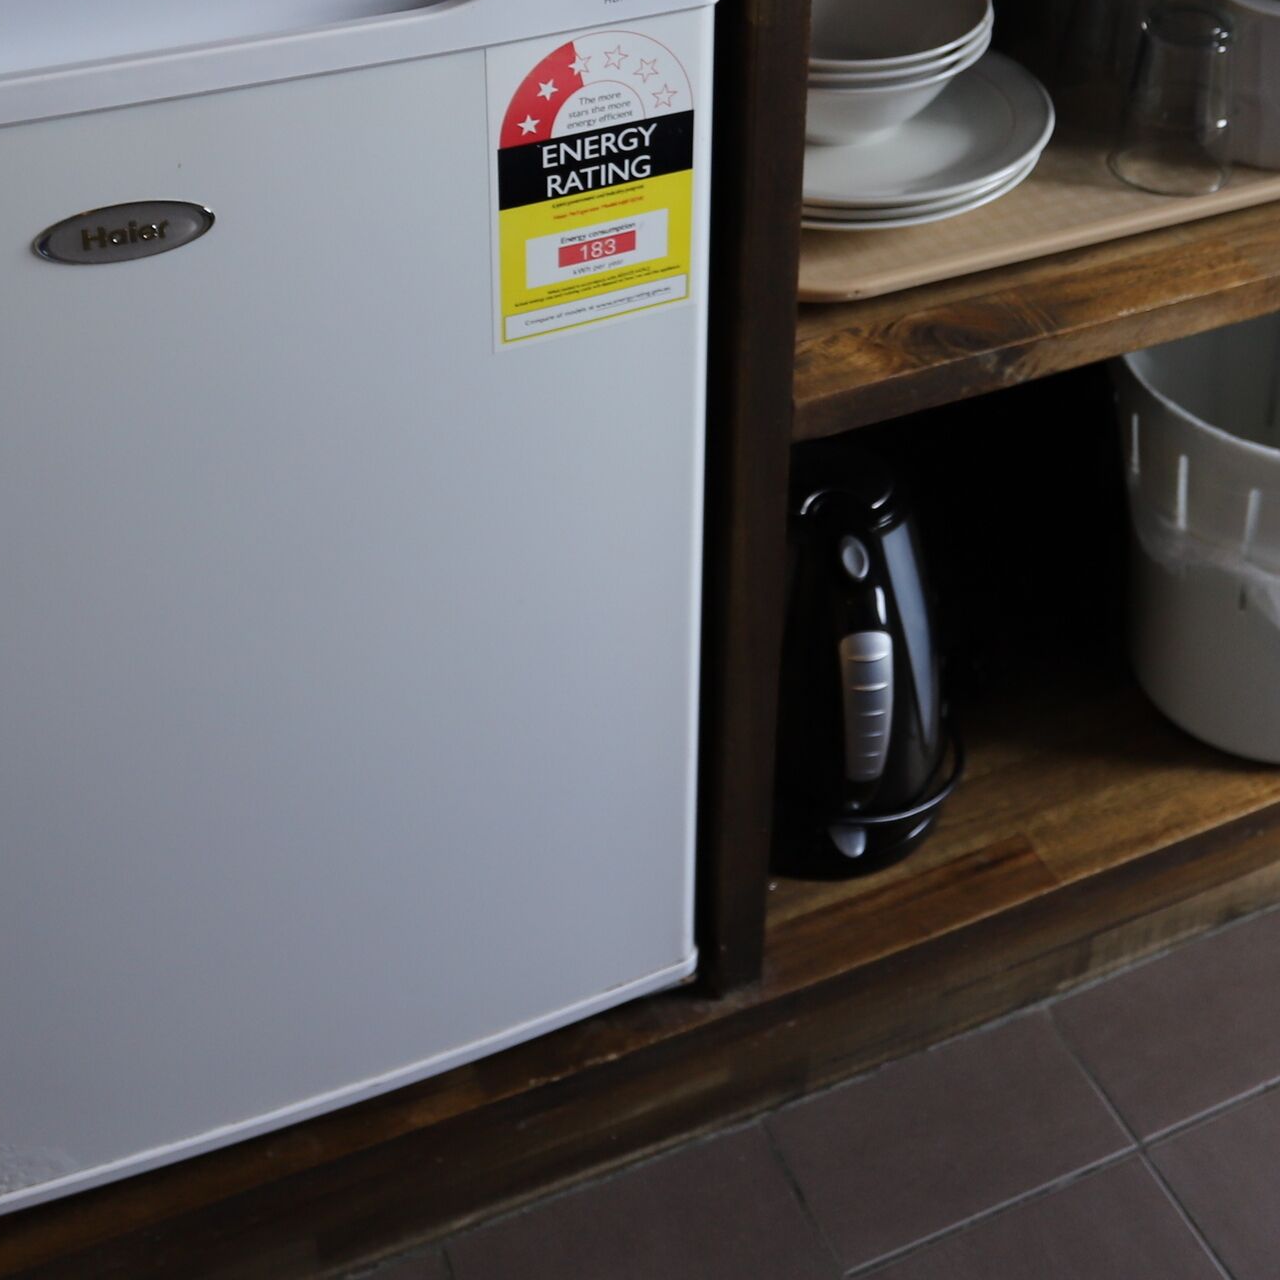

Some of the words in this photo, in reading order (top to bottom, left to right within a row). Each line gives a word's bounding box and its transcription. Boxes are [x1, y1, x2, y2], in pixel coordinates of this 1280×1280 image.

[568, 108, 589, 118] stars
[591, 105, 606, 114] the
[607, 100, 631, 110] more
[579, 96, 596, 106] The
[597, 92, 622, 101] more
[567, 118, 597, 130] energy
[598, 110, 633, 123] efficient
[541, 122, 658, 170] ENERGY
[546, 155, 652, 199] RATING
[81, 218, 170, 252] Haier
[579, 238, 616, 261] 183
